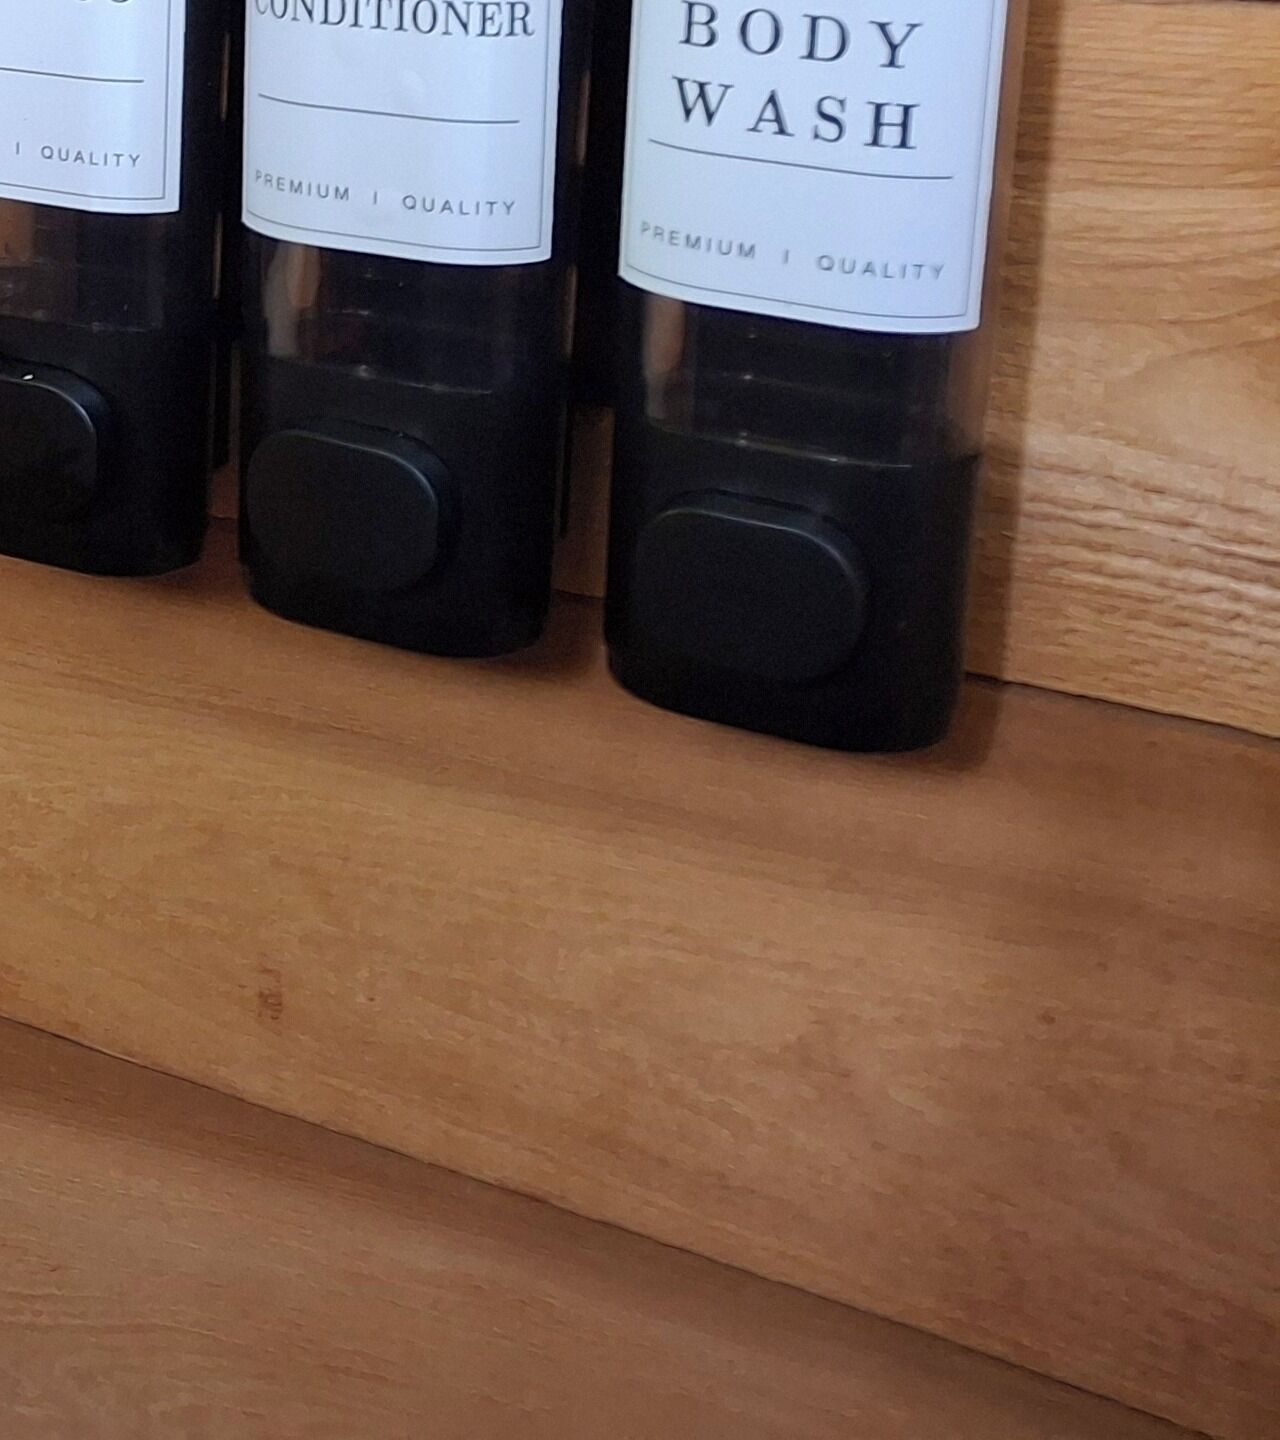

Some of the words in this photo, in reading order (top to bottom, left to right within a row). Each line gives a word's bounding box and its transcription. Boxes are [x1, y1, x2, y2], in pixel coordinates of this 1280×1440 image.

[678, 0, 924, 69] BODY
[671, 75, 920, 150] WASH
[40, 145, 141, 168] QUALITY
[255, 170, 350, 202] PREMIUM
[402, 194, 517, 217] QUALITY
[640, 221, 757, 259] PREMIUM
[816, 254, 946, 281] QUALITY
